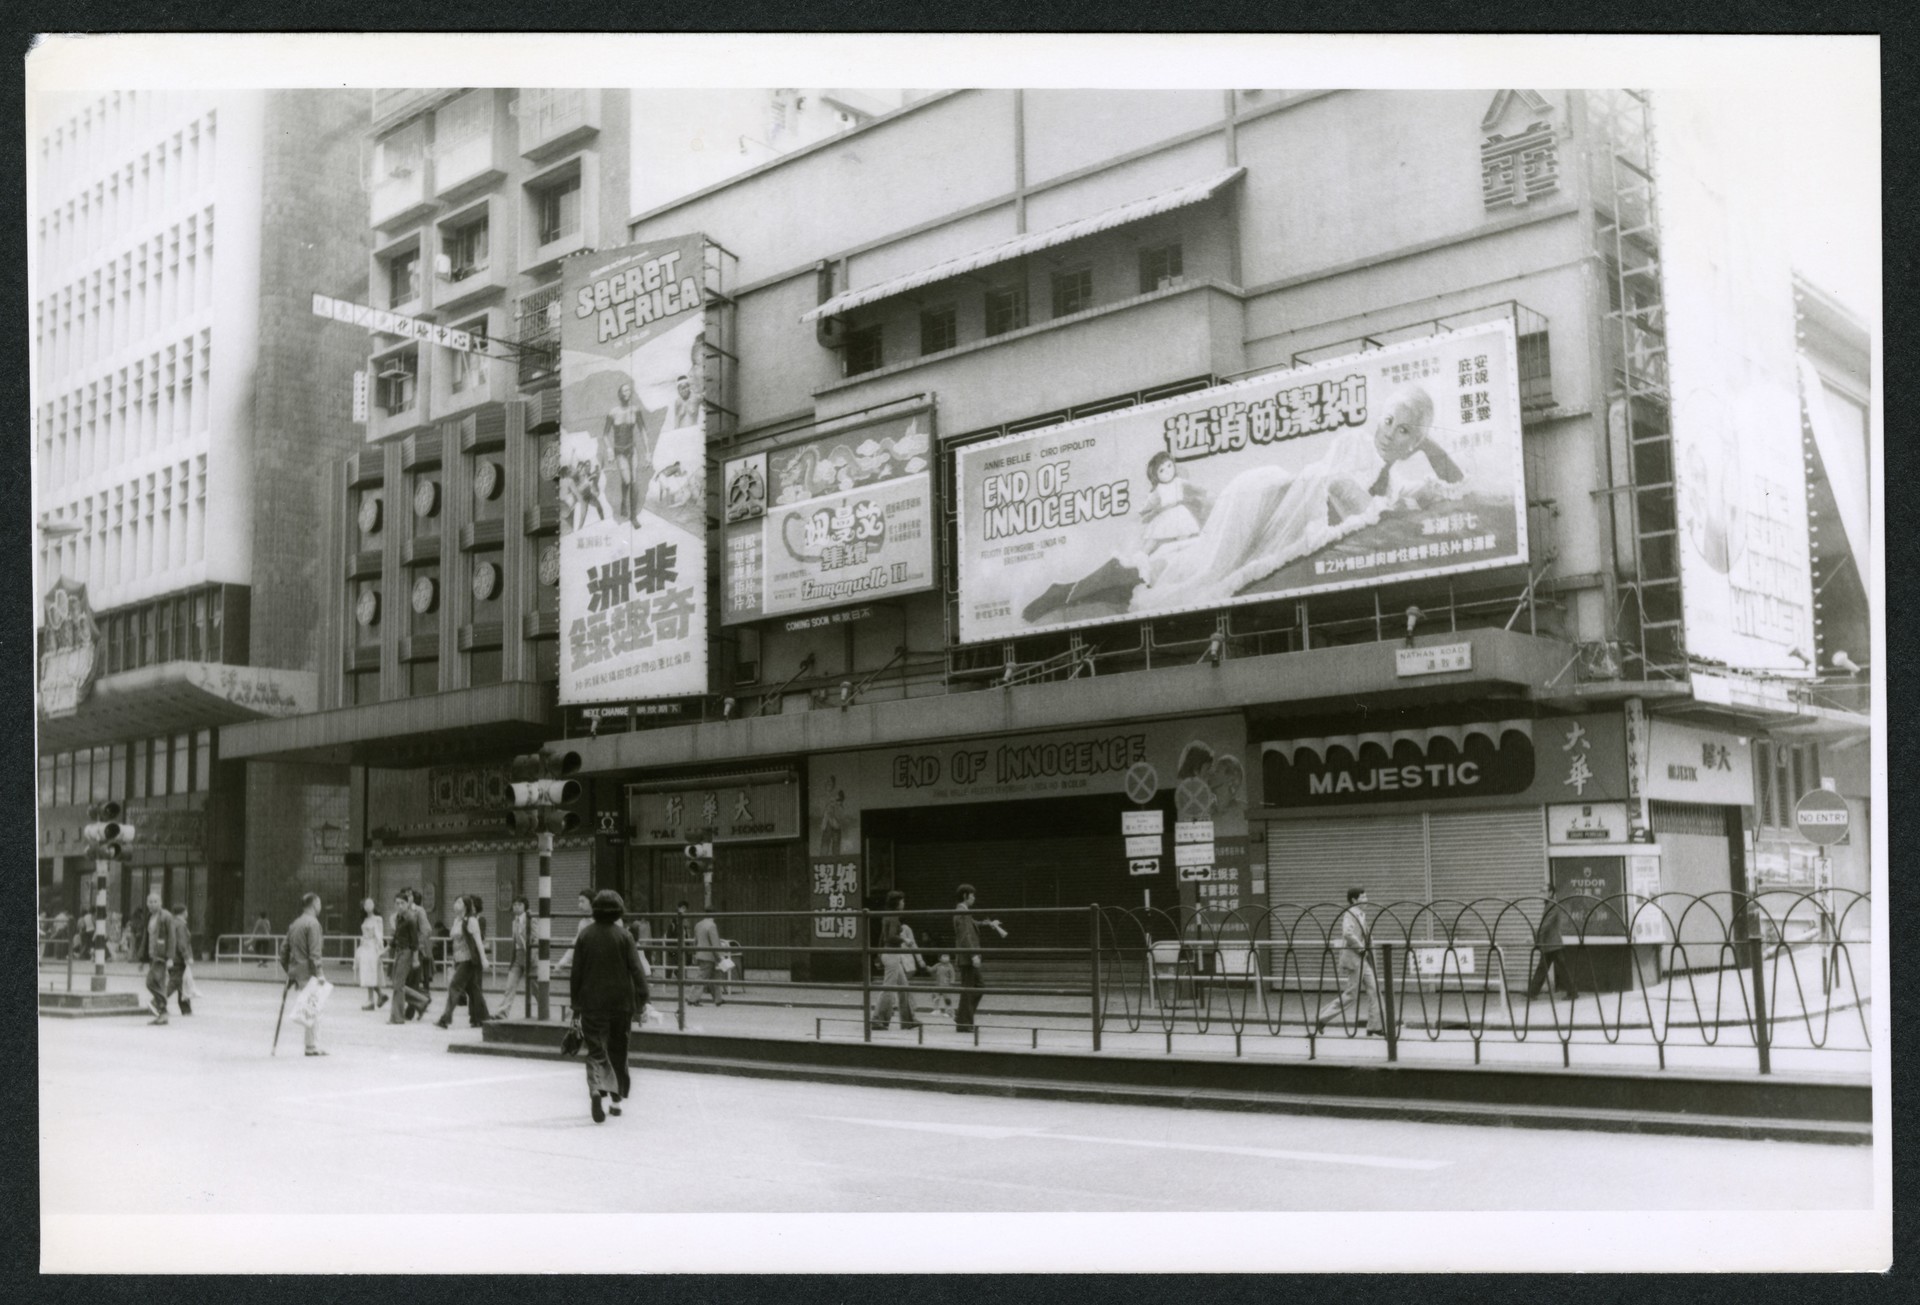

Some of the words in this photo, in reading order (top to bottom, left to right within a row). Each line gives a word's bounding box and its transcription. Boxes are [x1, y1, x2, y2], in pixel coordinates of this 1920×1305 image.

[576, 250, 681, 320] SECRET
[598, 276, 701, 344] AFRICA
[984, 456, 1005, 471] ANNIE
[1007, 452, 1031, 468] BELLE
[1040, 444, 1059, 459] CIRO
[1060, 438, 1096, 456] IPPOLITO
[983, 470, 1030, 510] END
[1036, 460, 1071, 499] OF
[984, 479, 1130, 541] INNOCENCE
[586, 541, 679, 613] 非洲
[801, 566, 888, 602] Emmanuelle
[786, 617, 810, 631] COMING
[812, 614, 829, 627] SOON
[1400, 649, 1434, 660] NATHAN
[1441, 646, 1465, 655] ROAD
[583, 708, 600, 719] NEXT
[601, 706, 629, 717] CHANGE
[893, 754, 941, 789] END
[951, 750, 988, 785] OF
[996, 733, 1147, 785] INNOCENCE
[1562, 721, 1594, 796] 大華
[1309, 761, 1481, 795] MAJESTIC
[651, 829, 675, 839] TAI
[732, 823, 775, 836] HONG
[1800, 814, 1813, 822] NO
[1816, 813, 1846, 822] ENTRY
[1570, 878, 1606, 888] TUDOR
